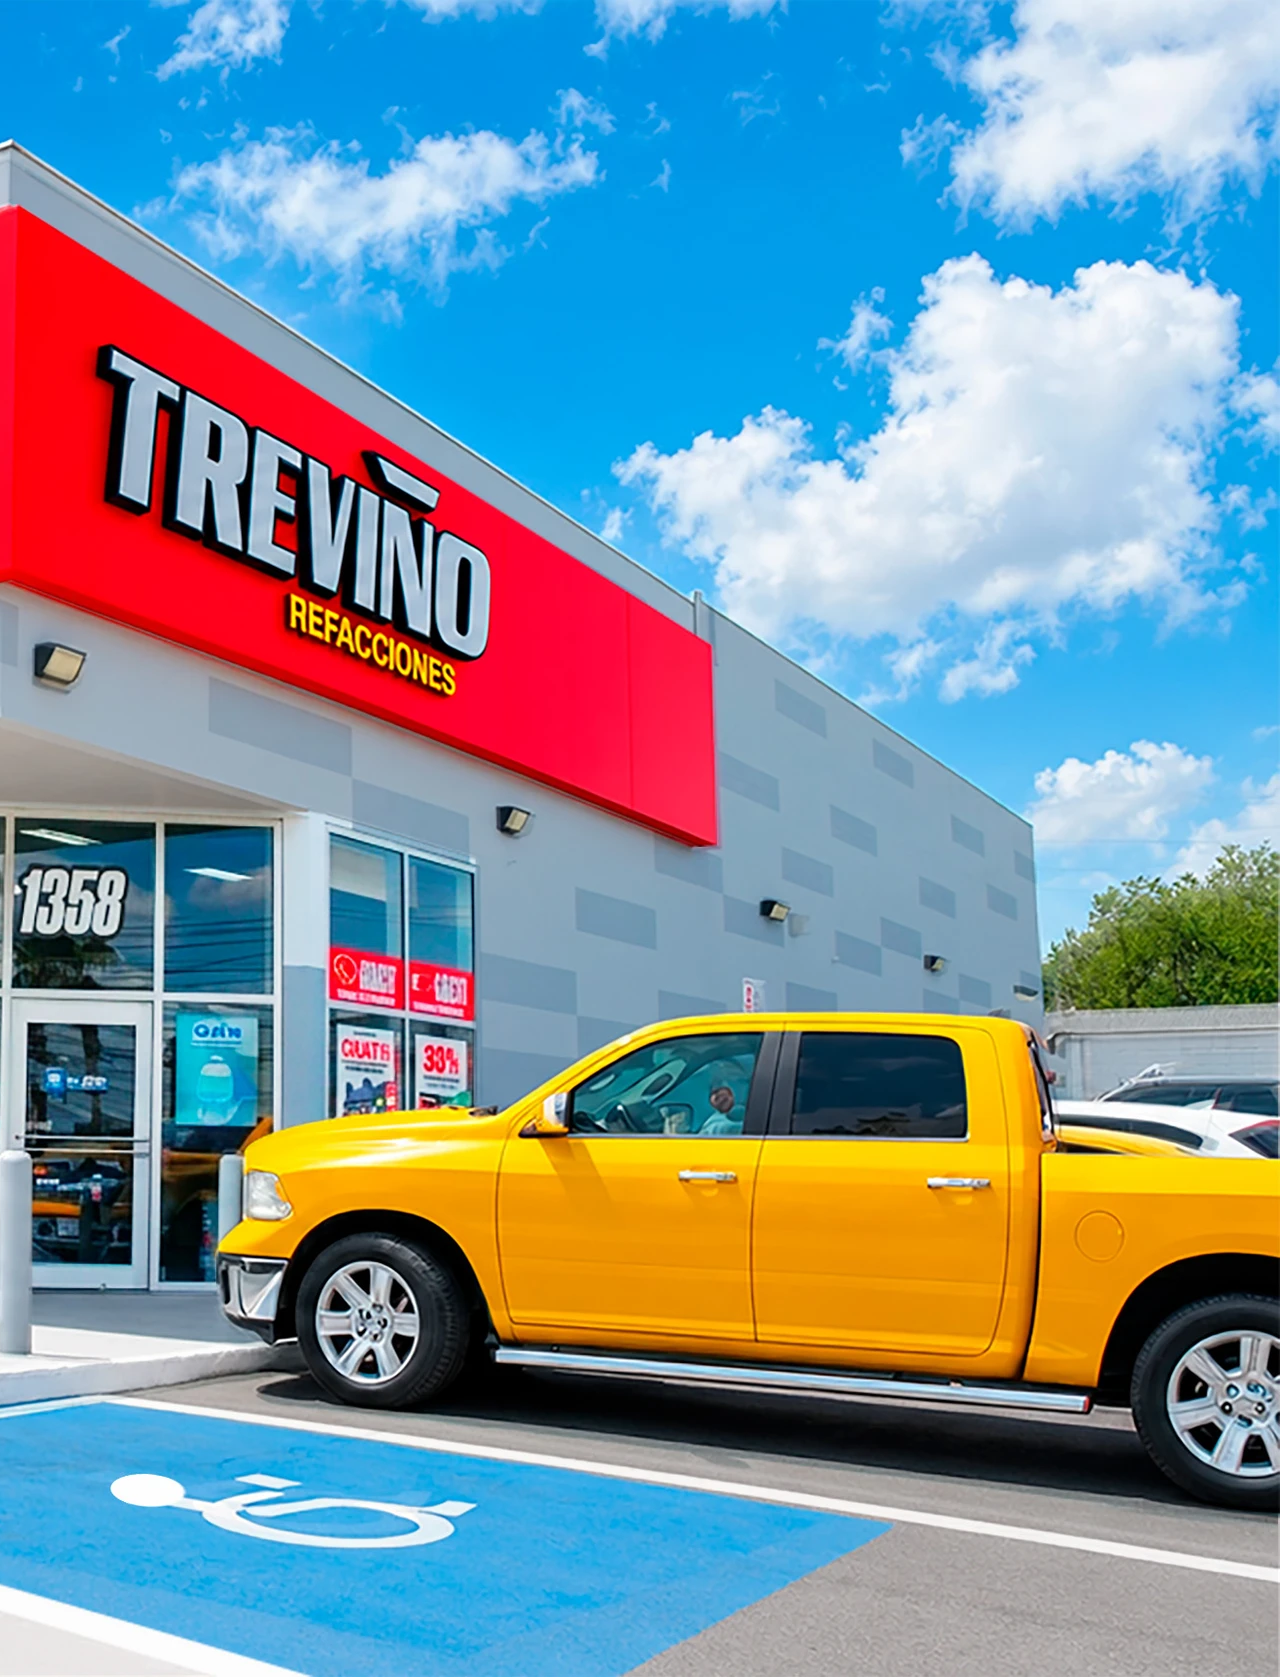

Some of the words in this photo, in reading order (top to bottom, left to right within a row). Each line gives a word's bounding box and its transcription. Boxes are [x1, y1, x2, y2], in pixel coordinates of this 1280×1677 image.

[96, 344, 491, 660] TREVIÑO
[287, 593, 456, 696] REFACCIONES
[20, 866, 128, 937] 1358
